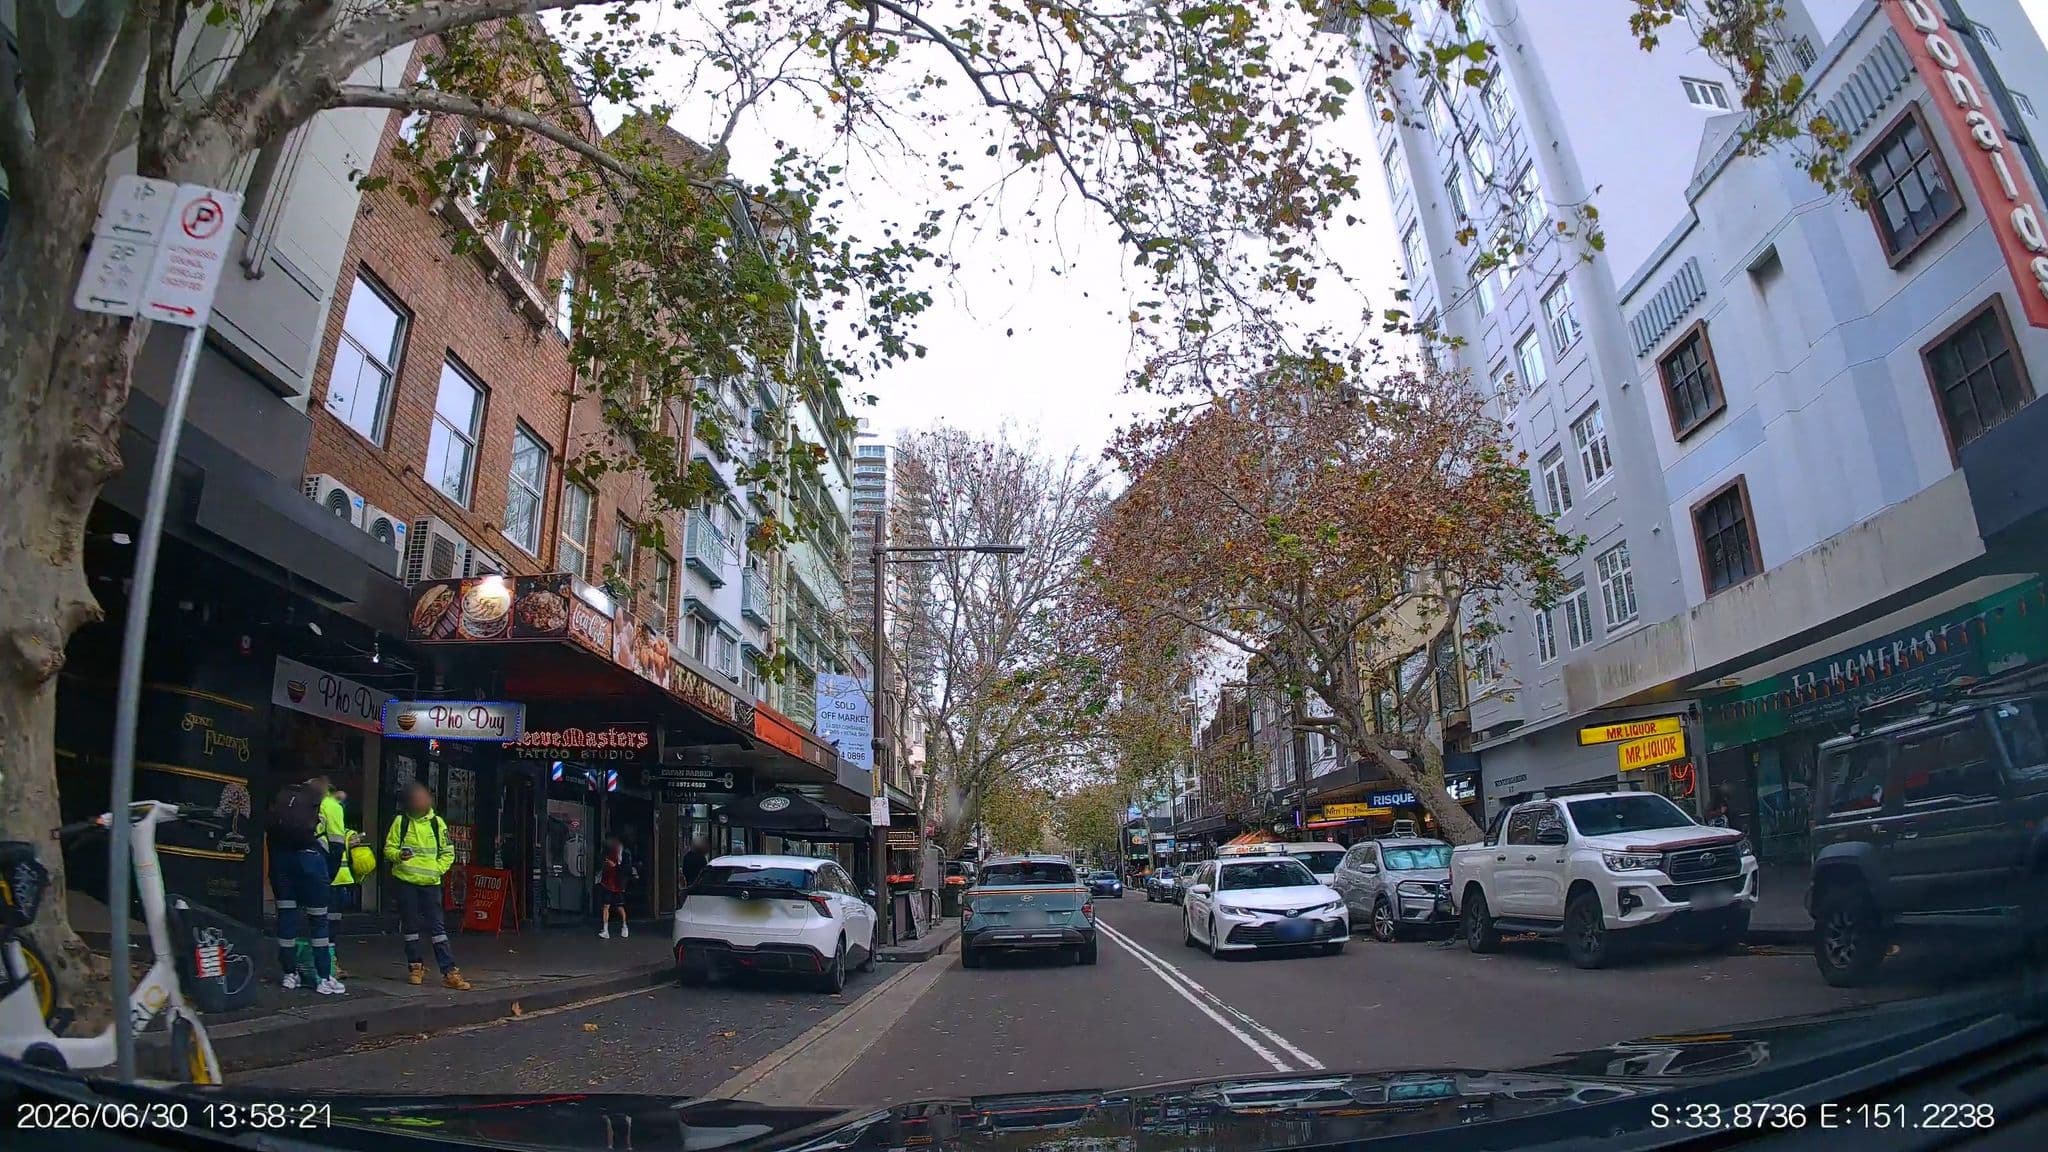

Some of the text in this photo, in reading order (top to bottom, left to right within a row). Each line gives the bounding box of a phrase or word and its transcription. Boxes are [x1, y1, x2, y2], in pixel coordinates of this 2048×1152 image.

[318, 675, 351, 713] Pho
[834, 700, 856, 711] SOLD
[429, 706, 506, 736] Pho Duy
[821, 711, 869, 724] OFF MARKET
[1606, 722, 1657, 740] MR LIQUOR
[516, 748, 634, 760] TATTOO STUDIO
[847, 752, 866, 760] 0896
[1625, 736, 1677, 765] MR LIQUOR
[1373, 792, 1416, 806] RISQUE
[473, 874, 502, 889] TATTOO
